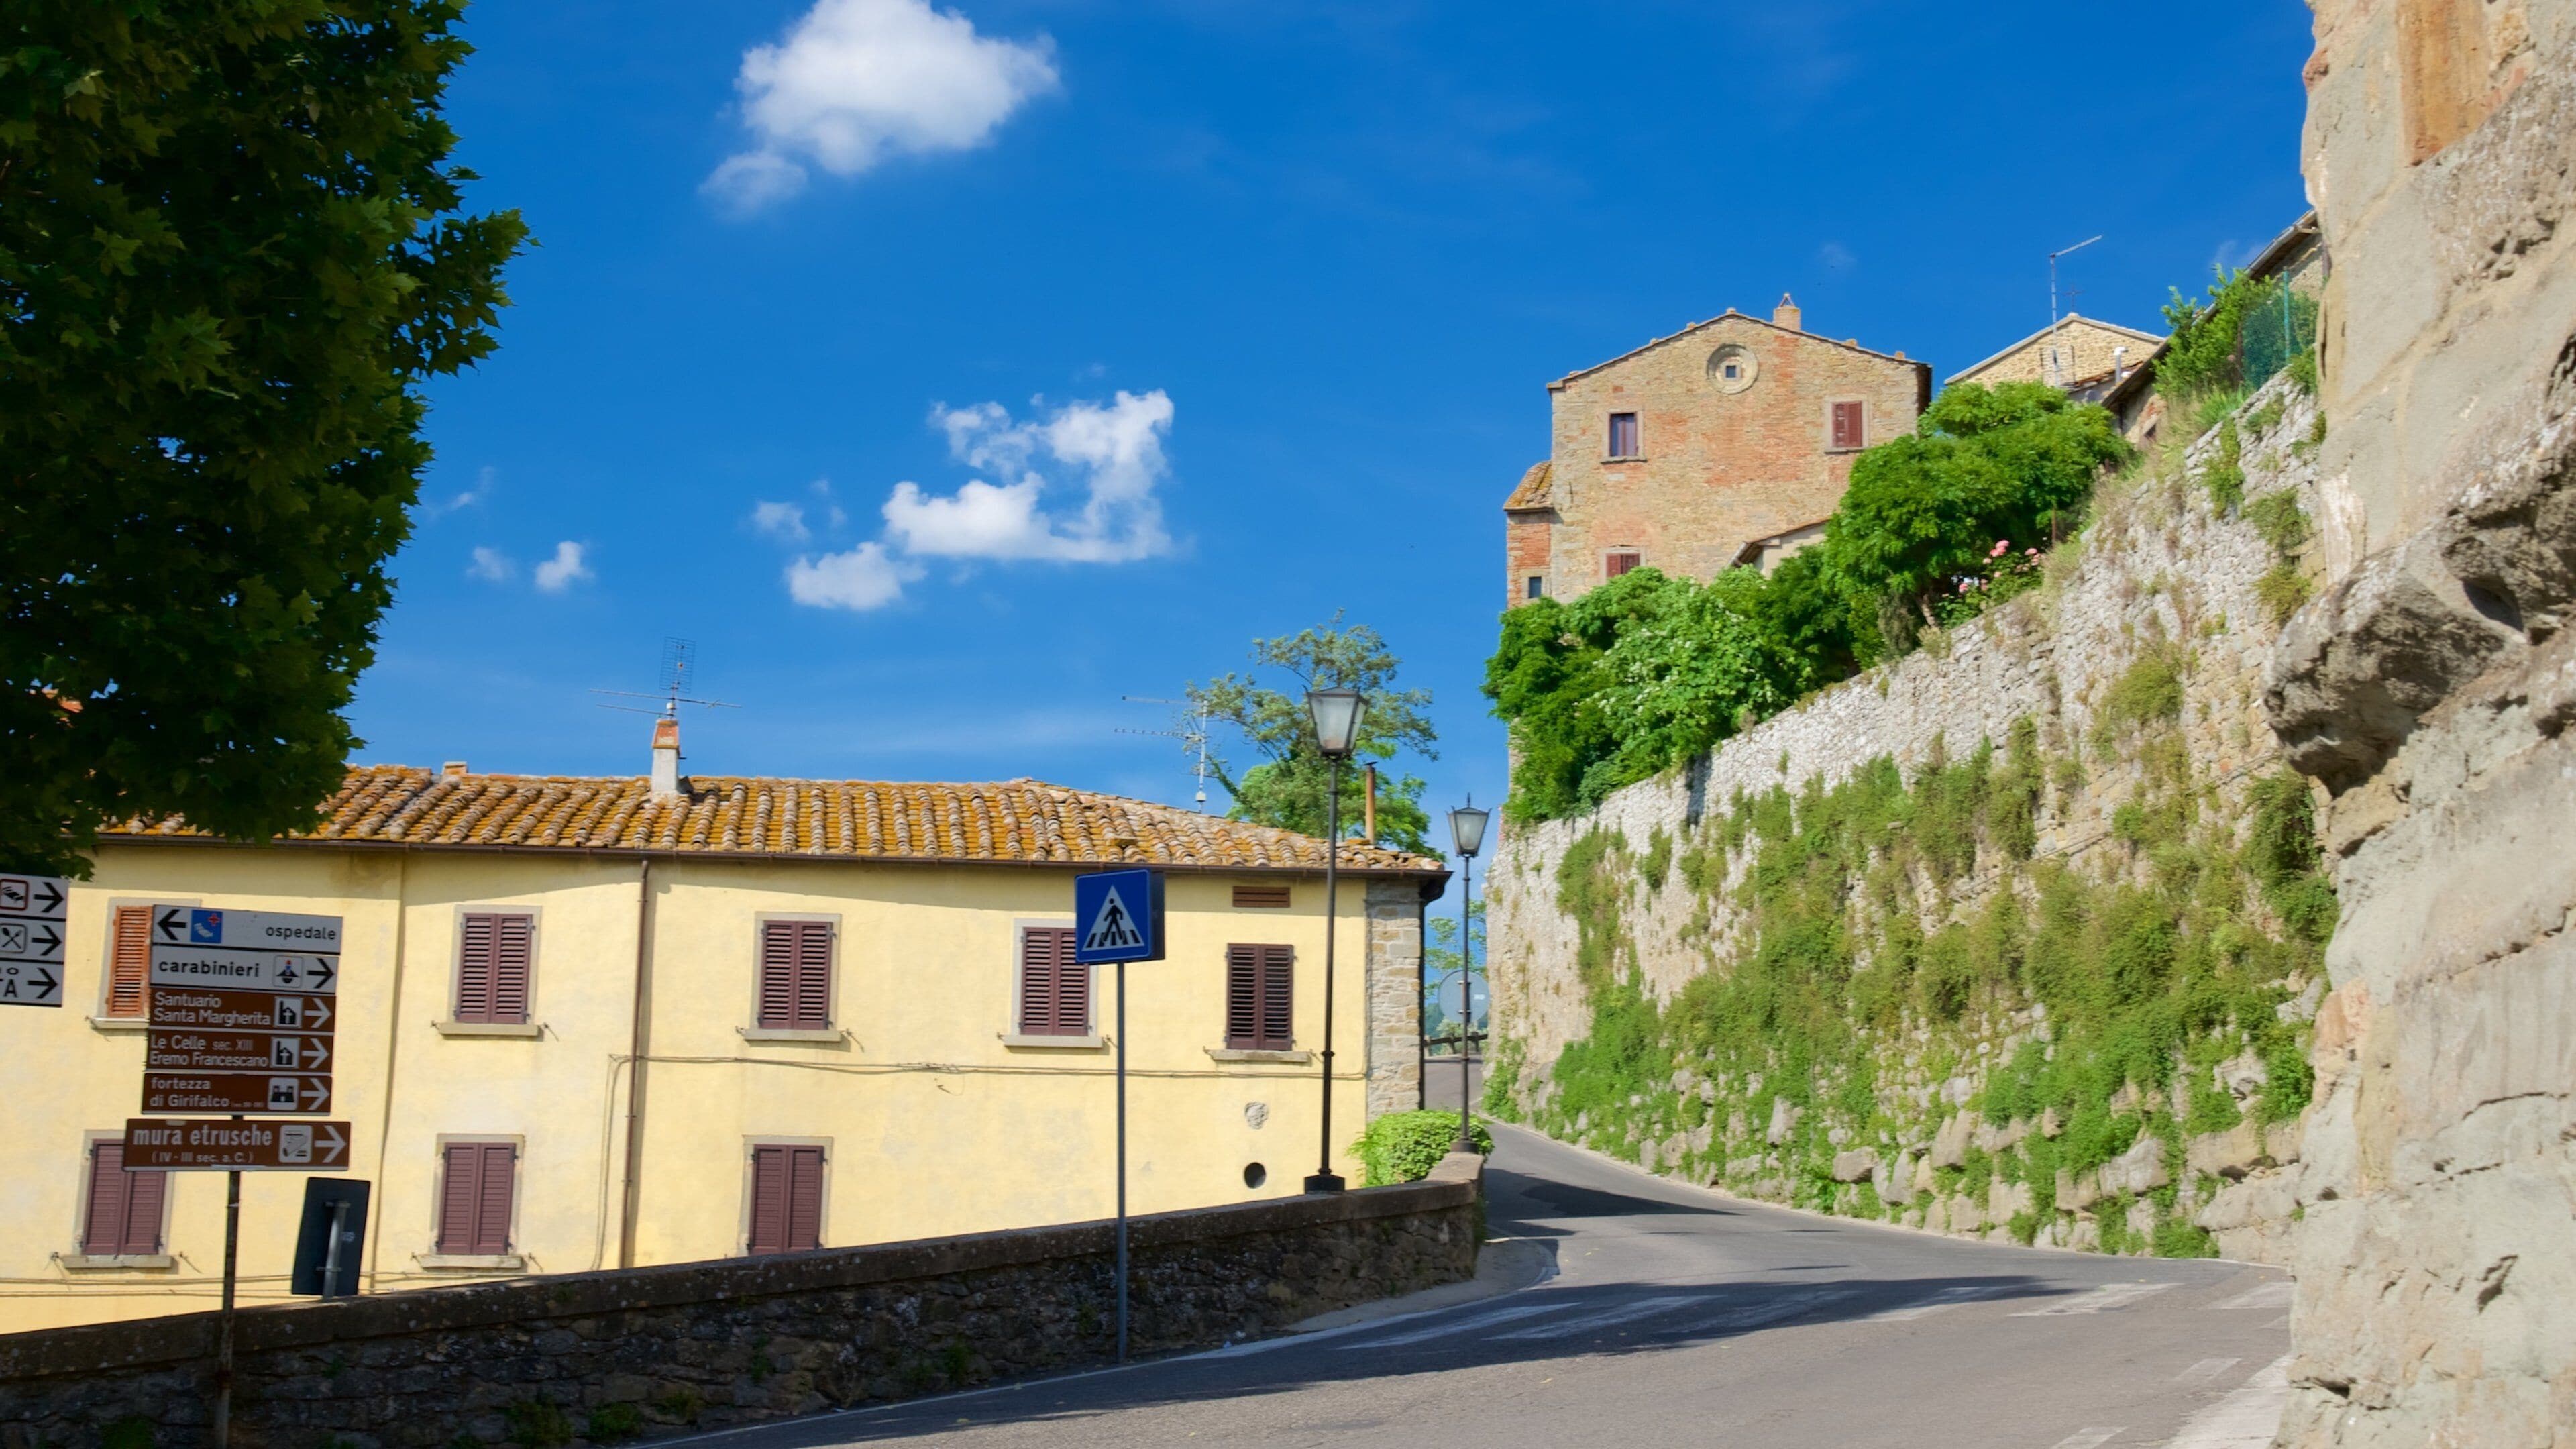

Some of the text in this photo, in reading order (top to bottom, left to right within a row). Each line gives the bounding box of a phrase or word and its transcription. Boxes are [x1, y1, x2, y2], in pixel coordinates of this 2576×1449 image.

[265, 925, 336, 940] ospedale
[158, 960, 260, 977] carabinieri
[0, 977, 18, 998] A
[154, 991, 222, 1008] Santuario
[153, 1006, 271, 1026] Santa Margherita
[150, 1034, 167, 1049] Le
[171, 1035, 207, 1051] Celle
[150, 1051, 268, 1067] Eremo Francescano
[151, 1077, 211, 1090] fortezza
[150, 1093, 164, 1107] di
[168, 1094, 230, 1108] Girifalco
[133, 1124, 272, 1146] mura etrusche
